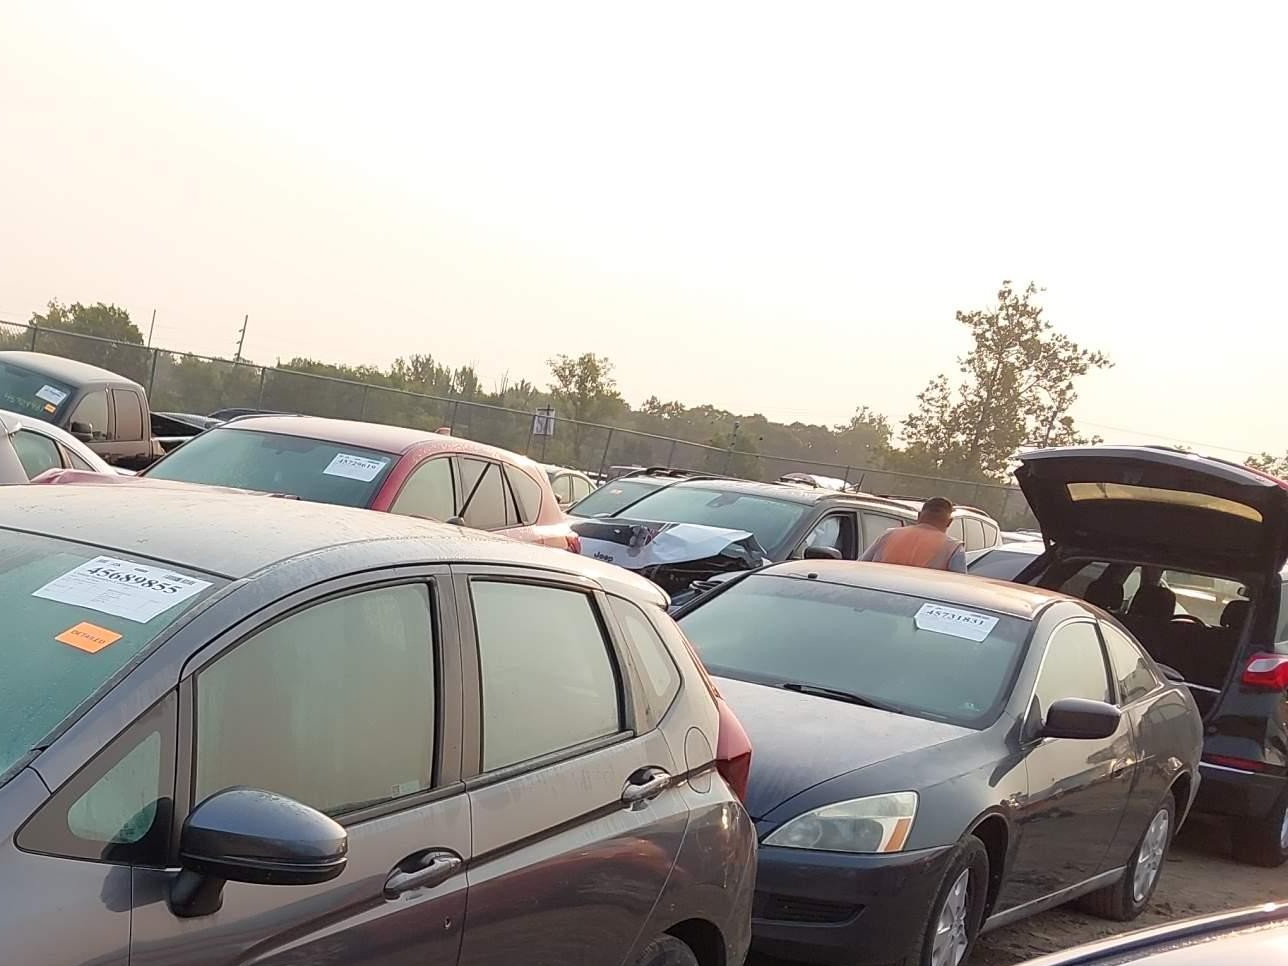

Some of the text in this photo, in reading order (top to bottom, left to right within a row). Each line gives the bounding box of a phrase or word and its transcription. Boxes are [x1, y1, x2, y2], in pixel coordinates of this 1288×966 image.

[593, 551, 614, 562] Jeep
[87, 566, 183, 594] 45689855
[70, 629, 107, 645] DETAILED
